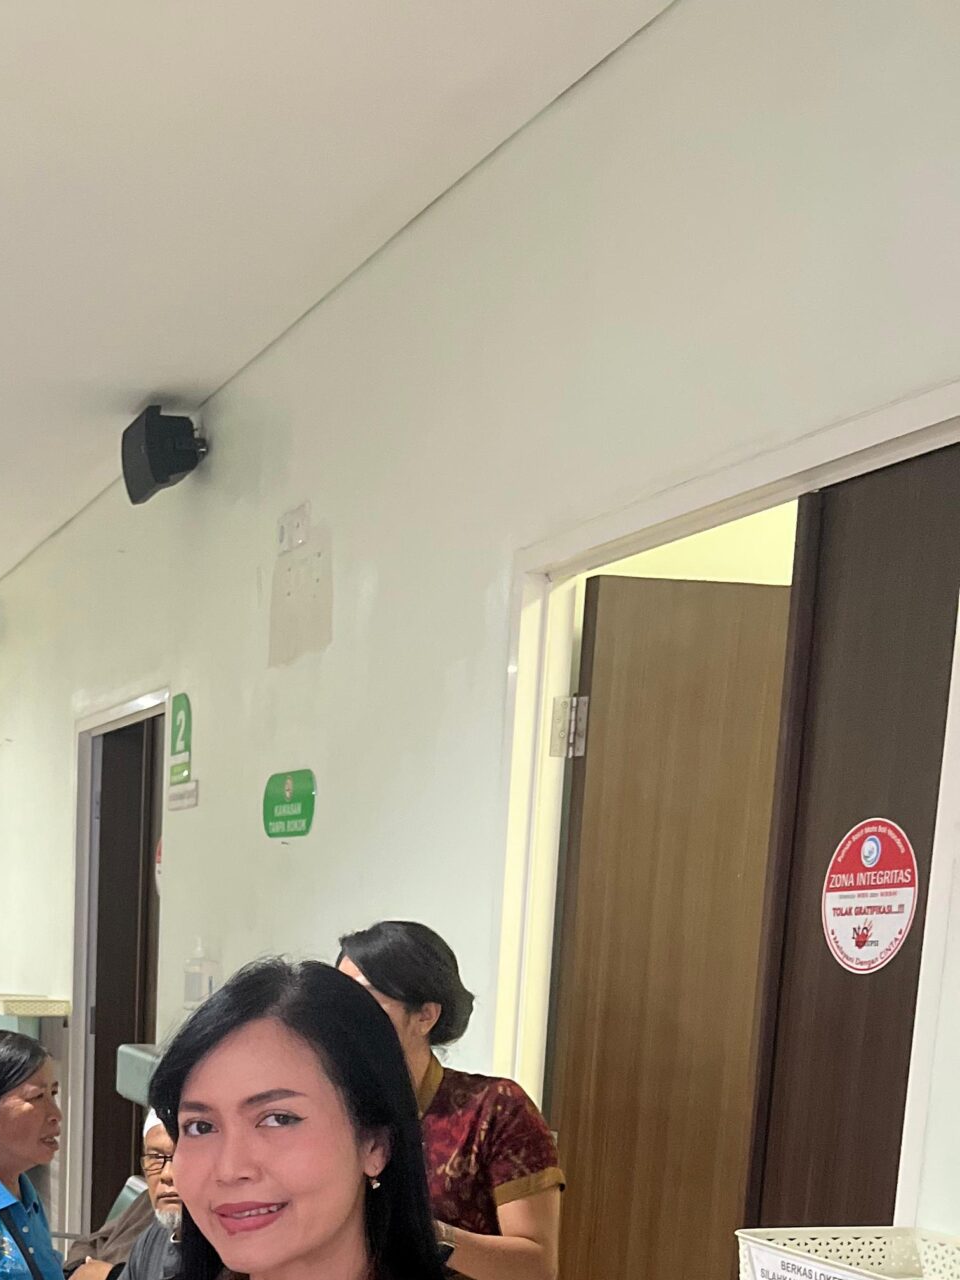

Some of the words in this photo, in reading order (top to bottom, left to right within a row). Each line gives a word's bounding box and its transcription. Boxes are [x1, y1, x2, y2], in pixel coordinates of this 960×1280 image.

[176, 710, 186, 752] 2
[829, 874, 855, 888] ZONA
[856, 869, 912, 886] INTEGRITAS
[832, 906, 853, 917] TOLAK
[879, 937, 899, 960] CINTA
[780, 1260, 813, 1280] BERKAS
